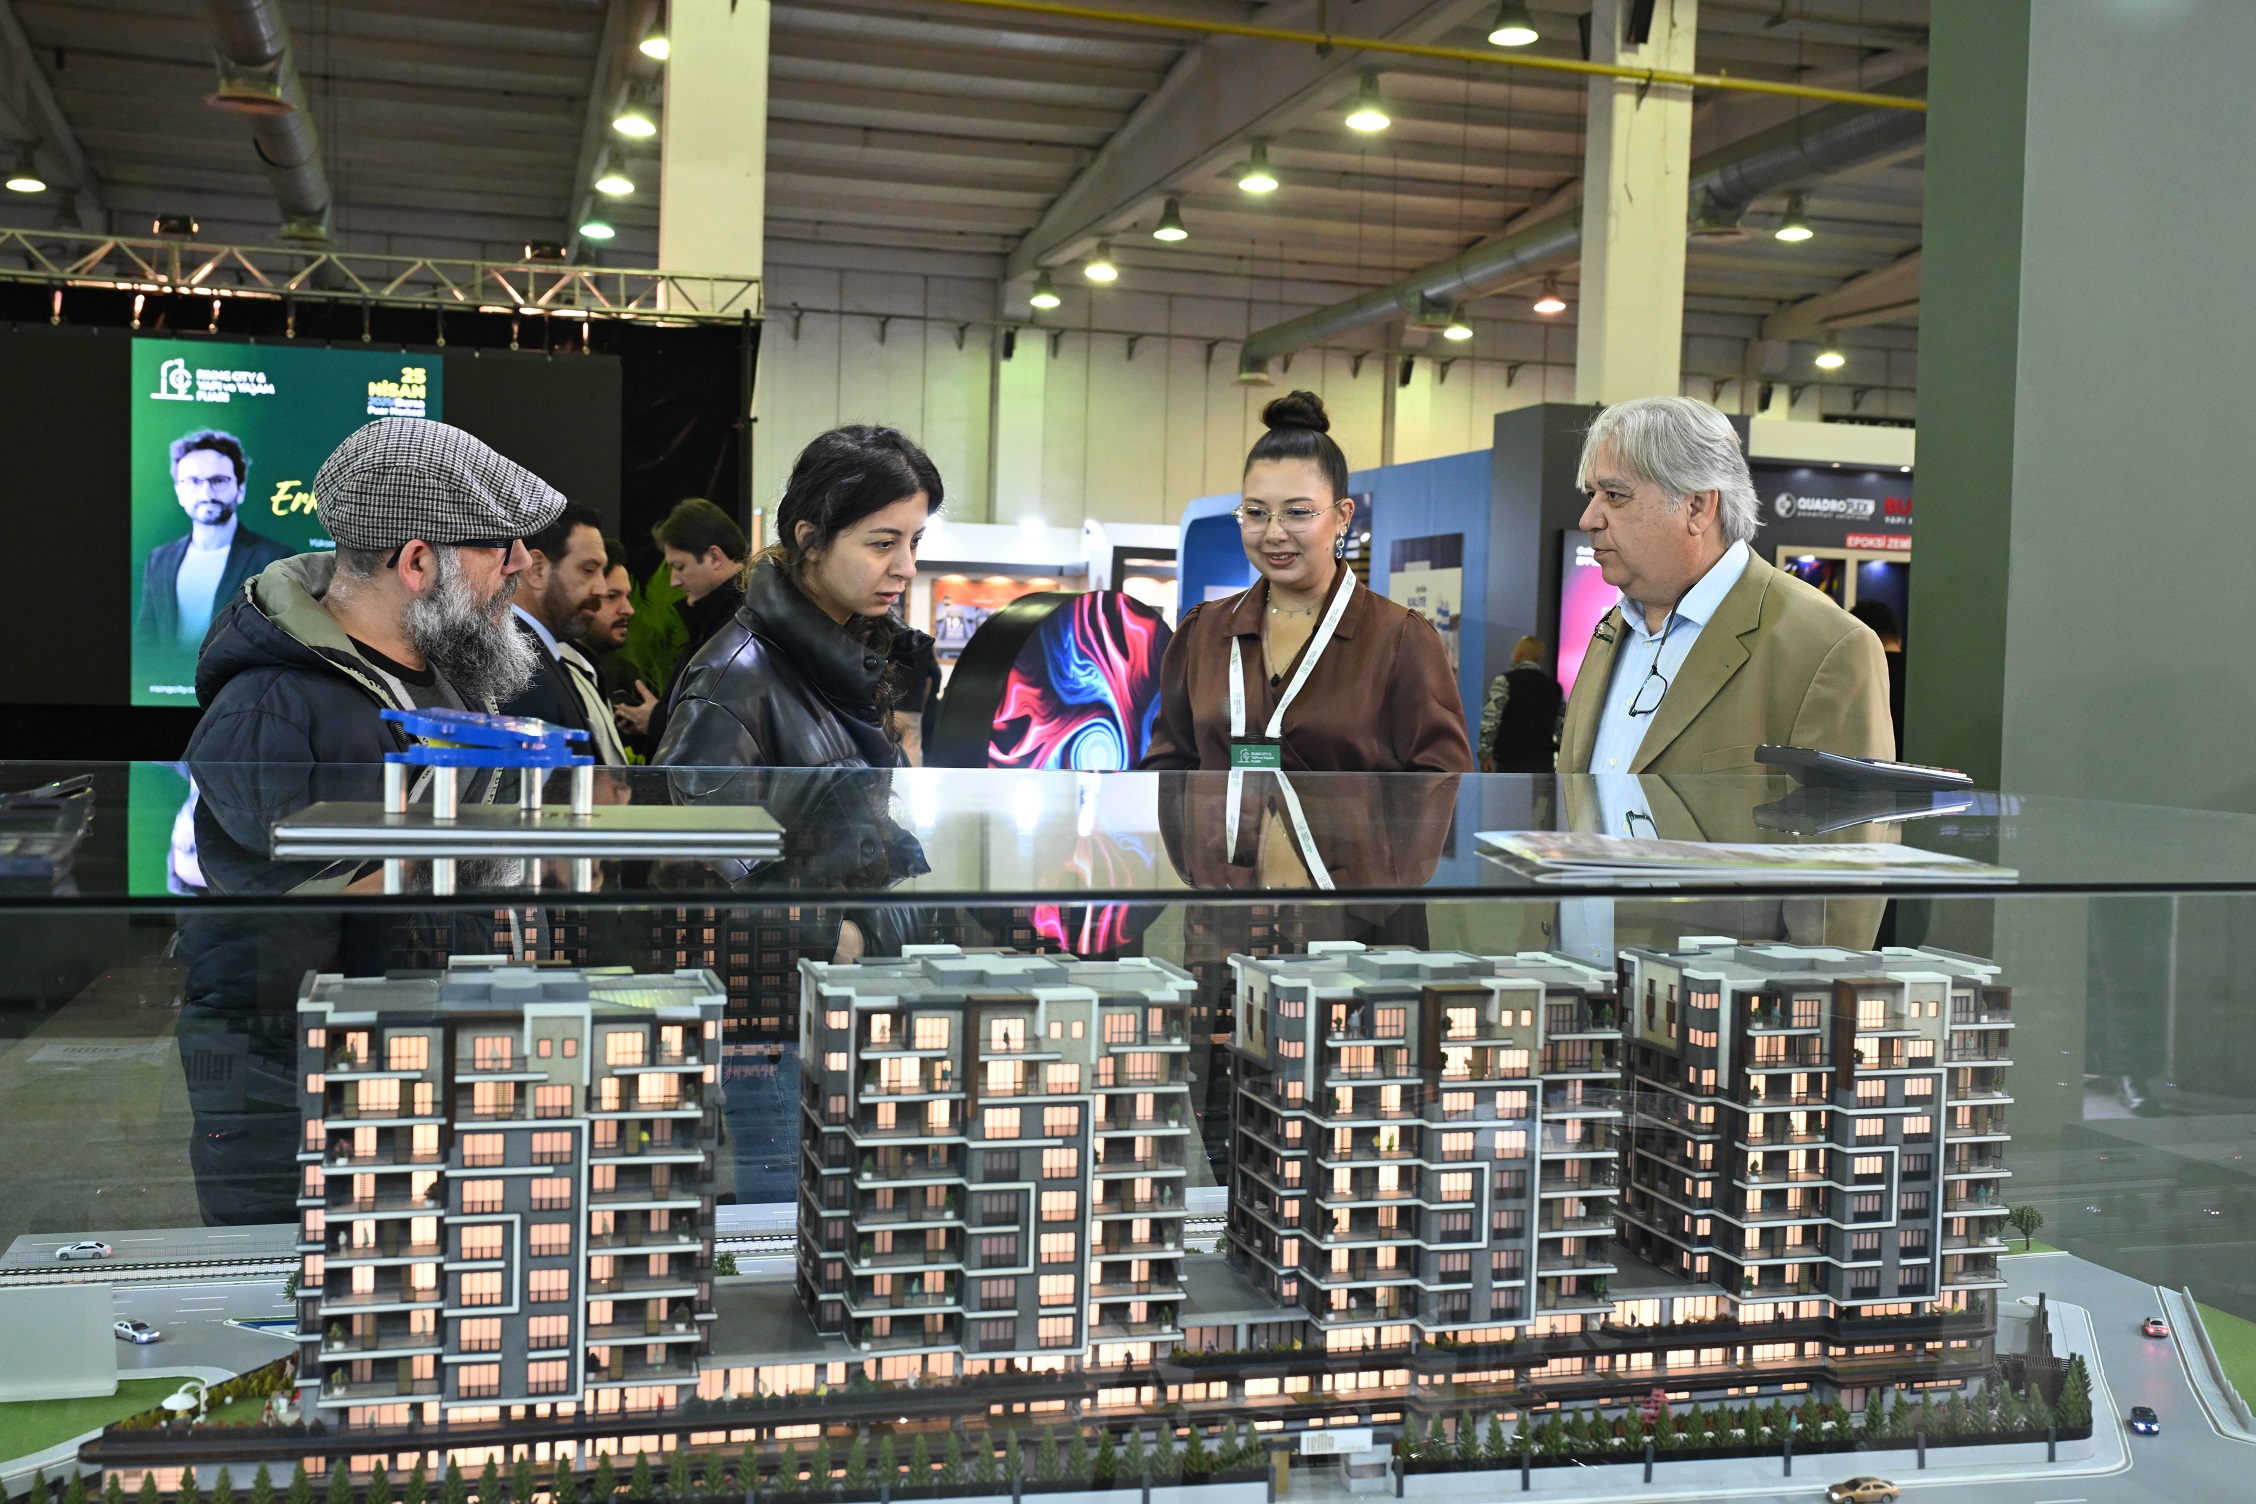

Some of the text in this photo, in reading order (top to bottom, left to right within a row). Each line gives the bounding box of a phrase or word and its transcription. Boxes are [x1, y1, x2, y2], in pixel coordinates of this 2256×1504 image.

[231, 371, 257, 383] CITY
[401, 367, 427, 384] 25
[368, 379, 426, 399] NİSAN
